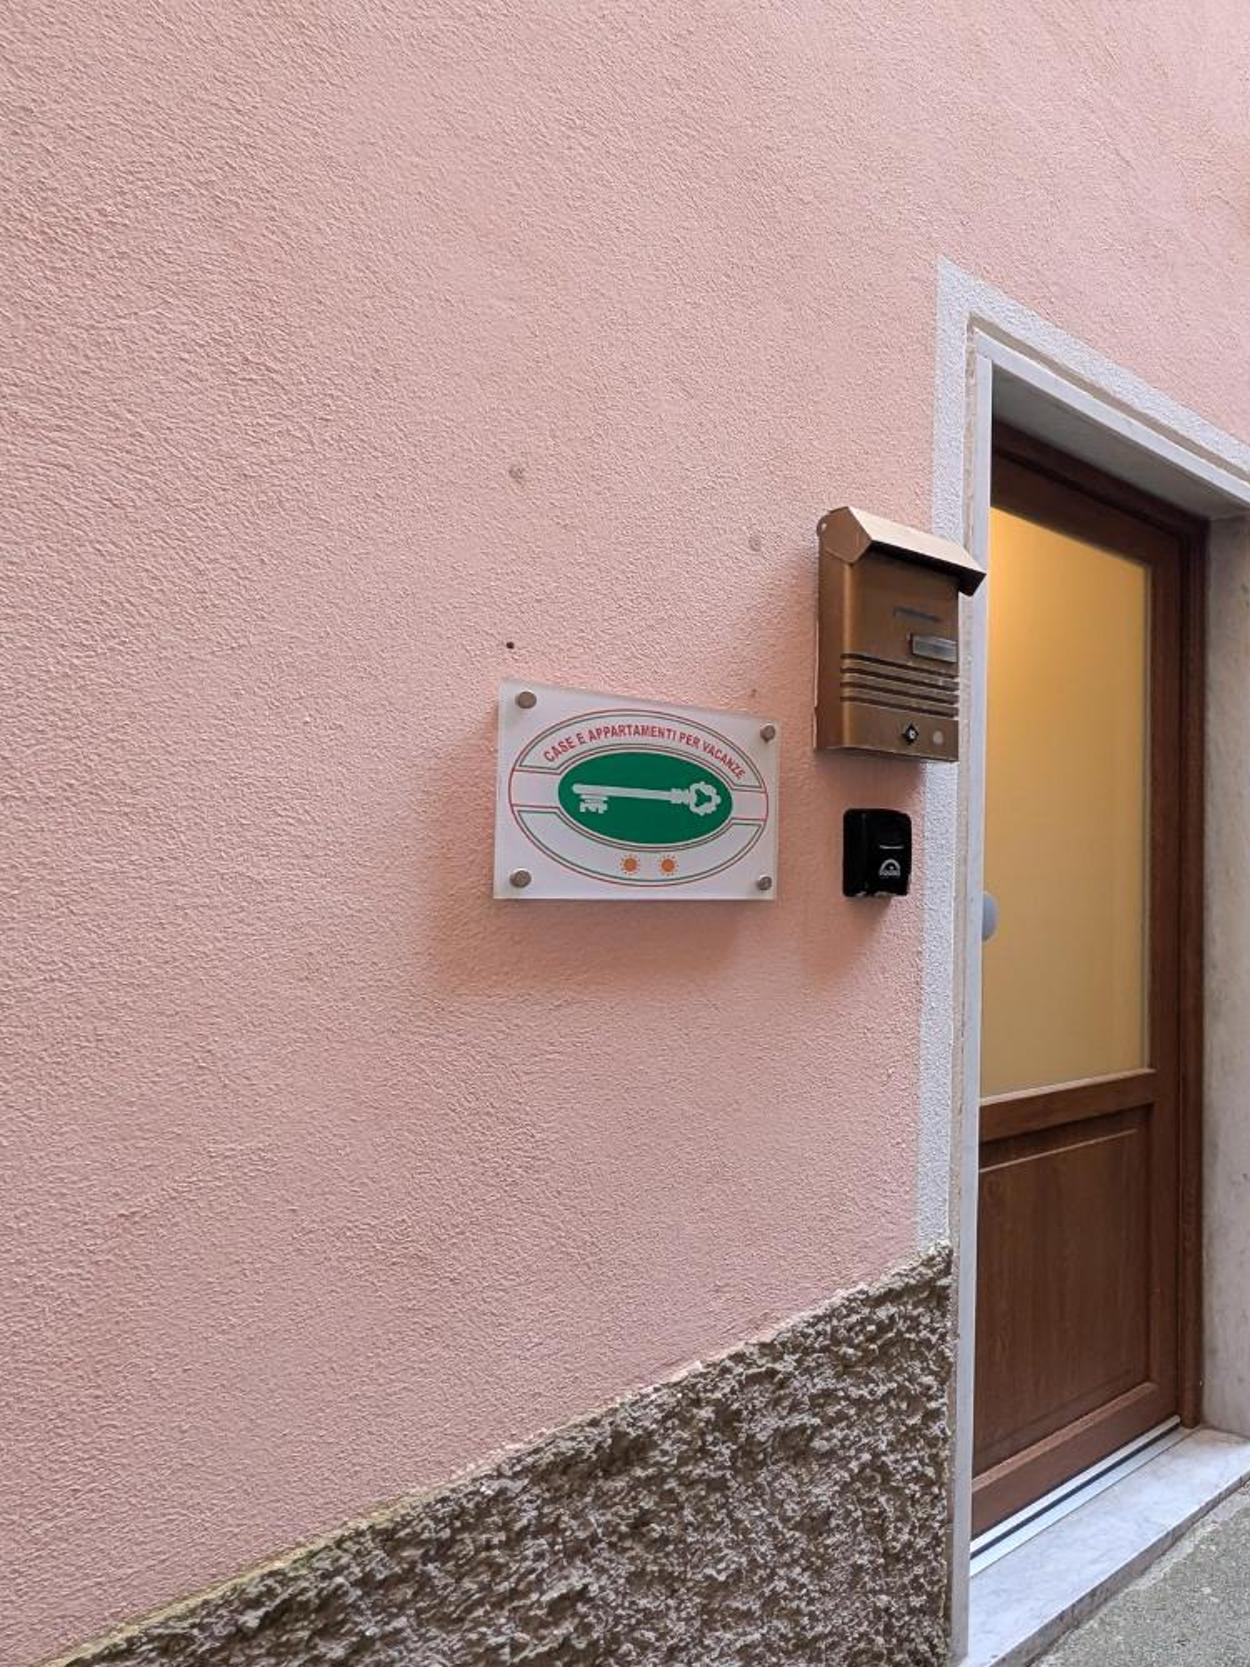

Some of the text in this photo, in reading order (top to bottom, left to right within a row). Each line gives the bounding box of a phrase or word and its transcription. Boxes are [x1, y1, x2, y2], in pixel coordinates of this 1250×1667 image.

[544, 724, 746, 780] CASE E APPARTAMENTI PER VACANZE
